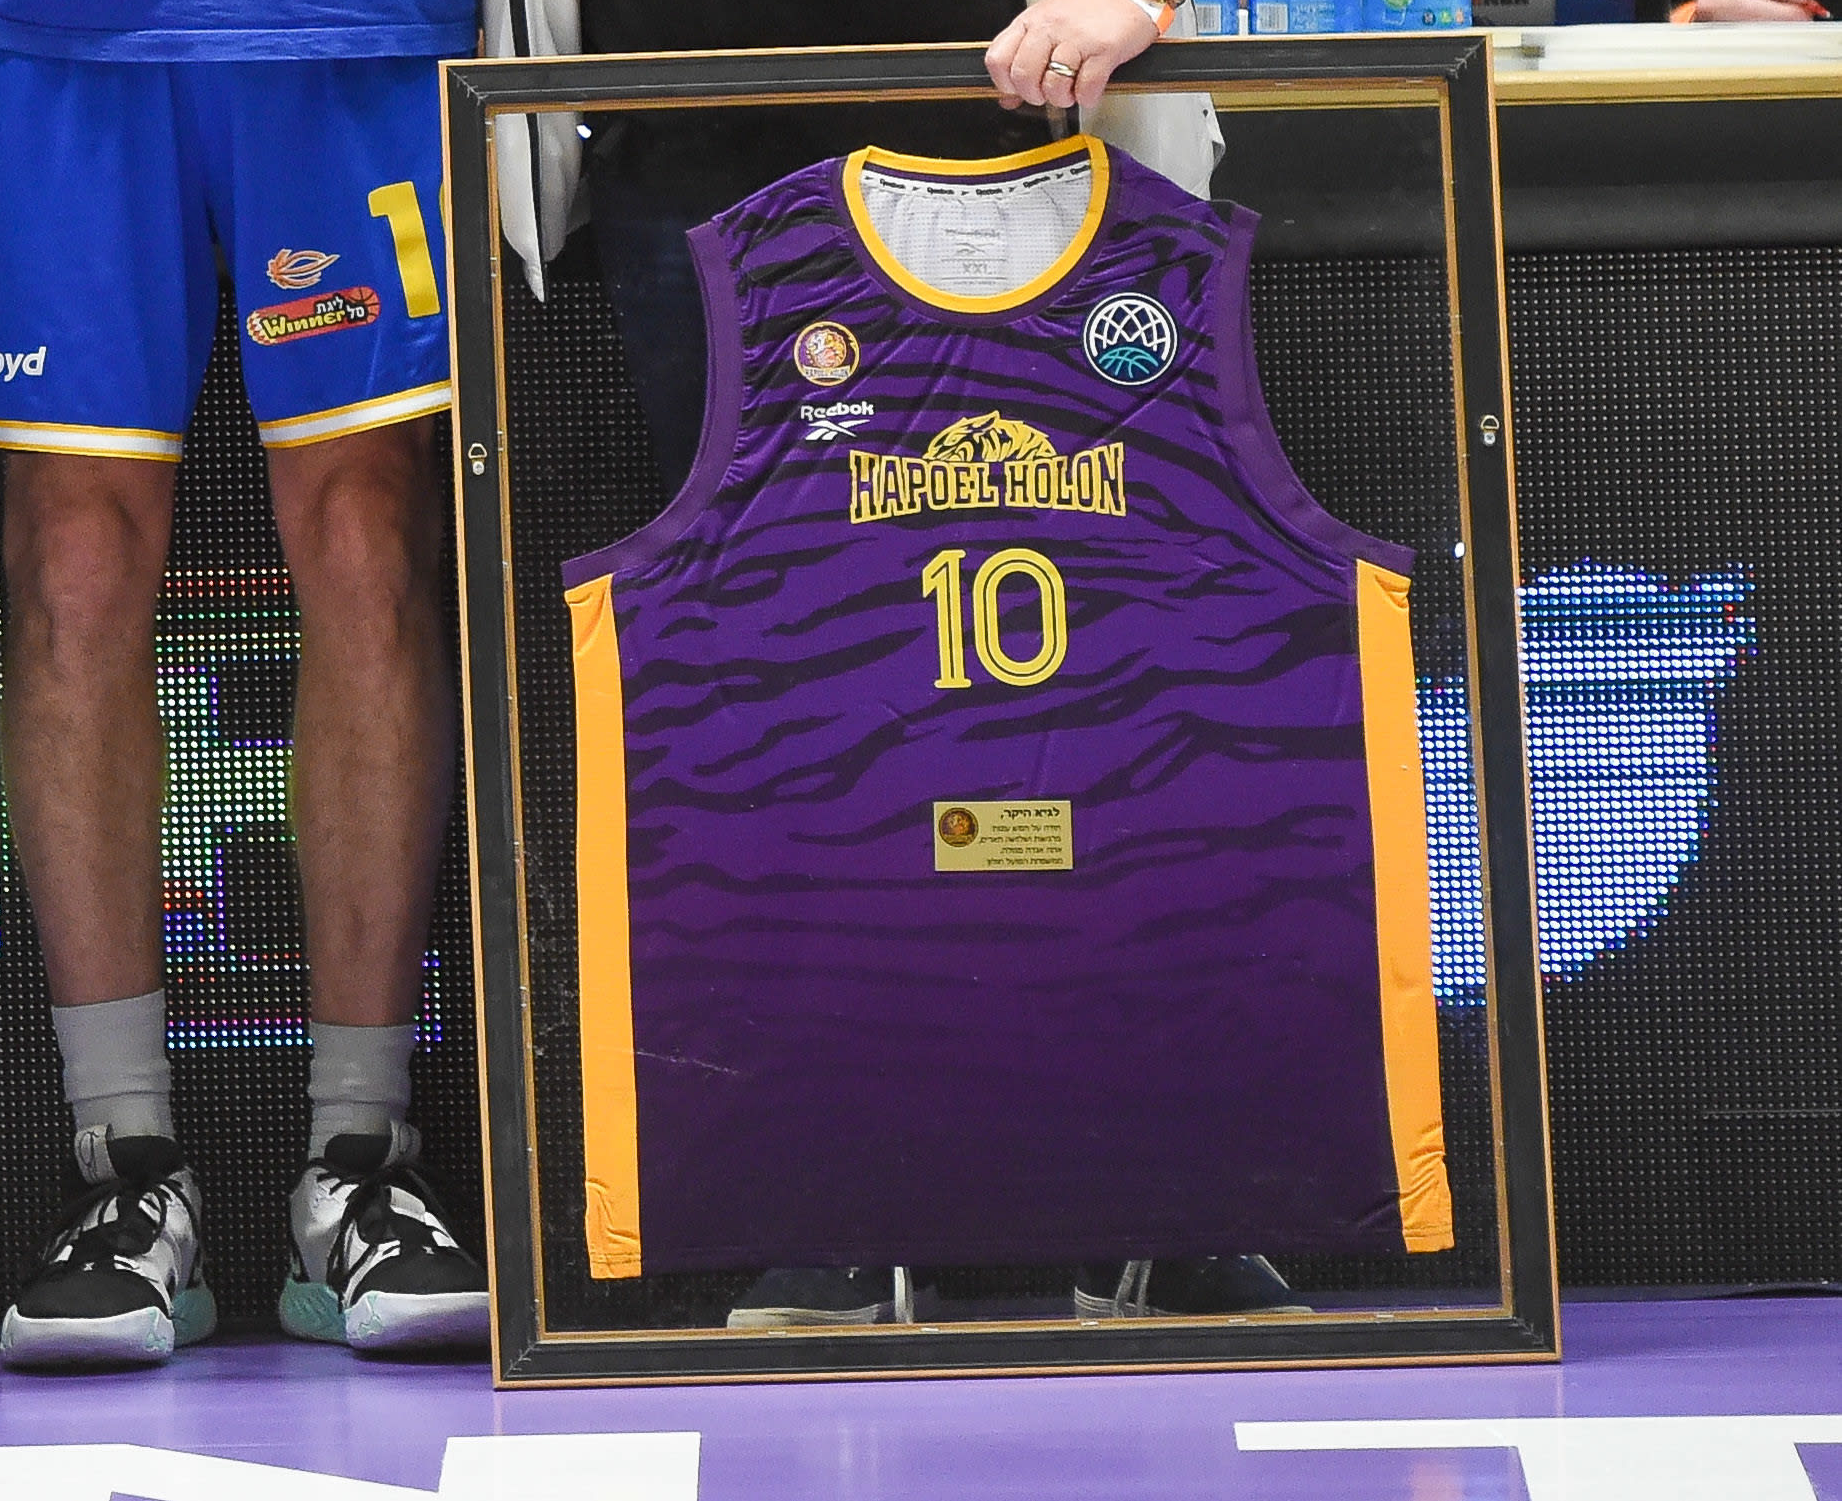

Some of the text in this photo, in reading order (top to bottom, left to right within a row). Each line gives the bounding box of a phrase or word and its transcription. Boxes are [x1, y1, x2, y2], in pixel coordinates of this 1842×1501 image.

[367, 181, 447, 319] 1
[262, 304, 365, 337] Winner סל
[316, 295, 344, 314] ליגת
[800, 401, 875, 421] Reebok
[849, 441, 1127, 524] HAPOEL HOLON
[922, 548, 1068, 689] 10
[1034, 807, 1060, 817] לגיא
